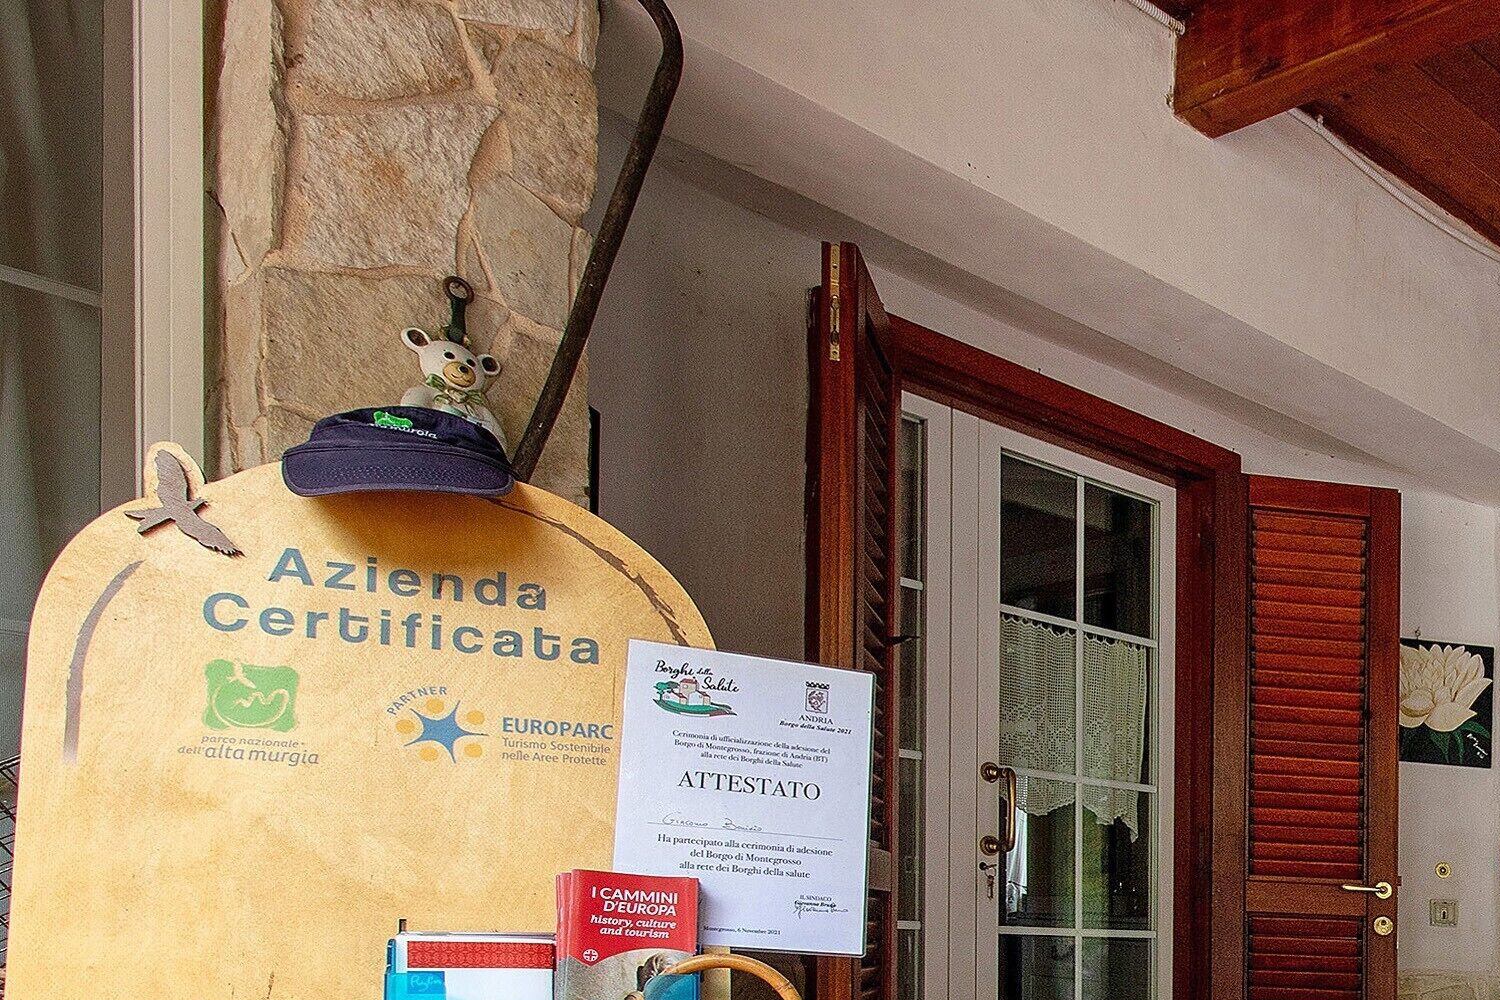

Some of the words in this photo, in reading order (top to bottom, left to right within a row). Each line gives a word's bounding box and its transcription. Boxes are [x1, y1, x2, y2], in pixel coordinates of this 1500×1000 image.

[268, 548, 547, 611] Azienda
[202, 592, 600, 665] Certificata
[654, 659, 694, 679] Borghi
[701, 675, 740, 693] Salute
[386, 685, 448, 716] PARTNER
[502, 716, 613, 740] EUROPARC
[779, 720, 799, 729] Borgo
[799, 714, 834, 725] ANDRIA
[201, 735, 236, 744] parco
[240, 738, 299, 748] nazionale
[502, 738, 547, 750] Turismo
[550, 741, 611, 754] Sostenibile
[672, 729, 709, 741] Cerimonia
[710, 733, 717, 741] di
[719, 734, 772, 749] ufficializzazione
[774, 741, 789, 750] della
[791, 743, 819, 753] adesione
[820, 746, 831, 754] del
[674, 738, 696, 749] Borgo
[697, 740, 705, 748] di
[753, 746, 780, 757] frazione
[781, 750, 788, 758] di
[790, 751, 812, 761] Andria
[248, 750, 319, 766] murgia
[502, 751, 529, 762] nelle
[532, 753, 558, 763] Aree
[562, 754, 607, 766] Protette
[700, 751, 712, 760] alla
[714, 752, 725, 761] rete
[728, 753, 739, 762] dei
[740, 755, 764, 765] Borghi
[765, 757, 781, 766] della
[782, 759, 803, 769] Salute
[677, 770, 822, 801] ATTESTATO
[658, 833, 671, 844] Ha
[673, 836, 723, 849] partecipato
[725, 839, 740, 848] alla
[742, 841, 785, 853] cerimonia
[786, 844, 794, 853] di
[797, 846, 833, 857] adesione
[690, 849, 704, 858] del
[706, 850, 733, 861] Borgo
[735, 852, 744, 861] di
[746, 853, 802, 867] Montegrosso
[679, 862, 694, 871] alla
[697, 863, 713, 871] rete
[716, 864, 730, 873] dei
[731, 864, 762, 876] Borghi
[763, 867, 784, 877] della
[786, 869, 811, 880] salute
[592, 886, 596, 899] I
[600, 887, 678, 904] CAMMINI
[603, 900, 676, 917] D'EUROPA
[591, 914, 633, 928] history,
[636, 919, 676, 930] culture
[600, 926, 622, 936] and
[625, 927, 669, 939] tourism
